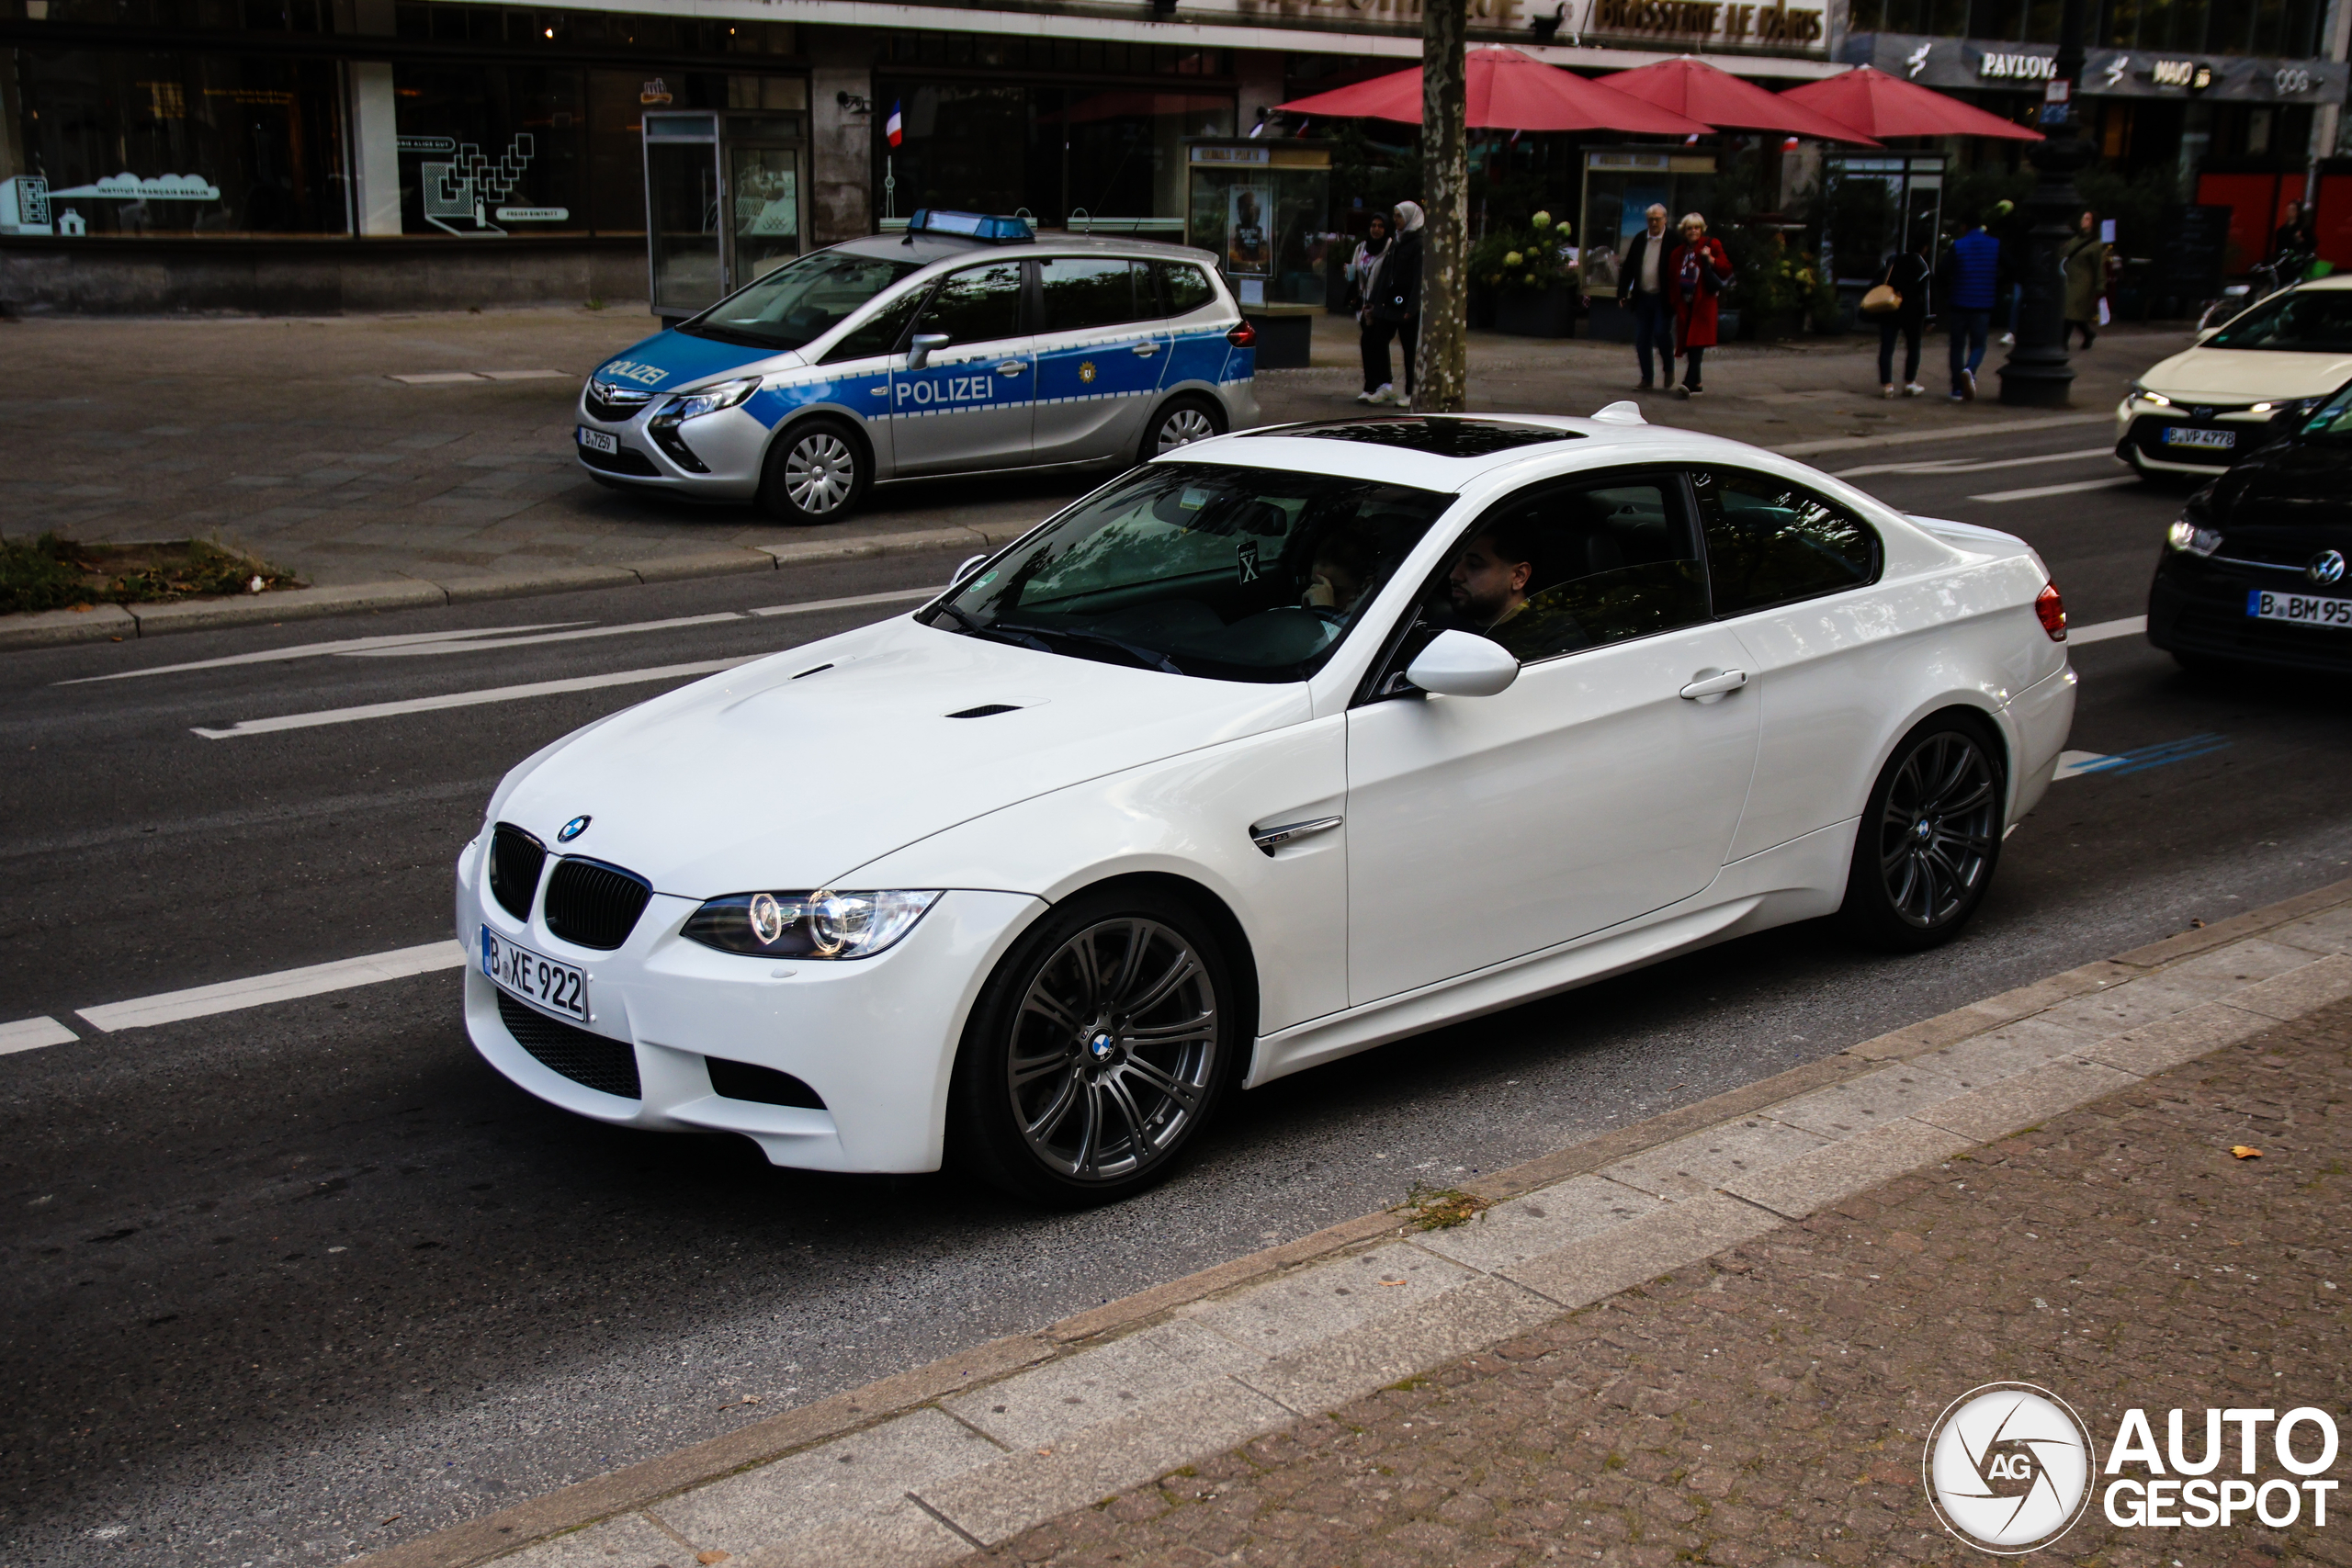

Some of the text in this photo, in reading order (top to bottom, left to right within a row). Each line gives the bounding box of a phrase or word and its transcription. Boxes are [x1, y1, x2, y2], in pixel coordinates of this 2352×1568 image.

[1595, 0, 1823, 39] BRASSERIE LE PARIS
[598, 360, 670, 386] POLIZEI
[896, 375, 993, 406] POLIZEI
[585, 430, 611, 450] B 7259
[2169, 428, 2234, 446] B VP 4778
[1240, 554, 1259, 583] X
[2259, 592, 2352, 623] B BM 95
[491, 935, 582, 1014] B XE 922
